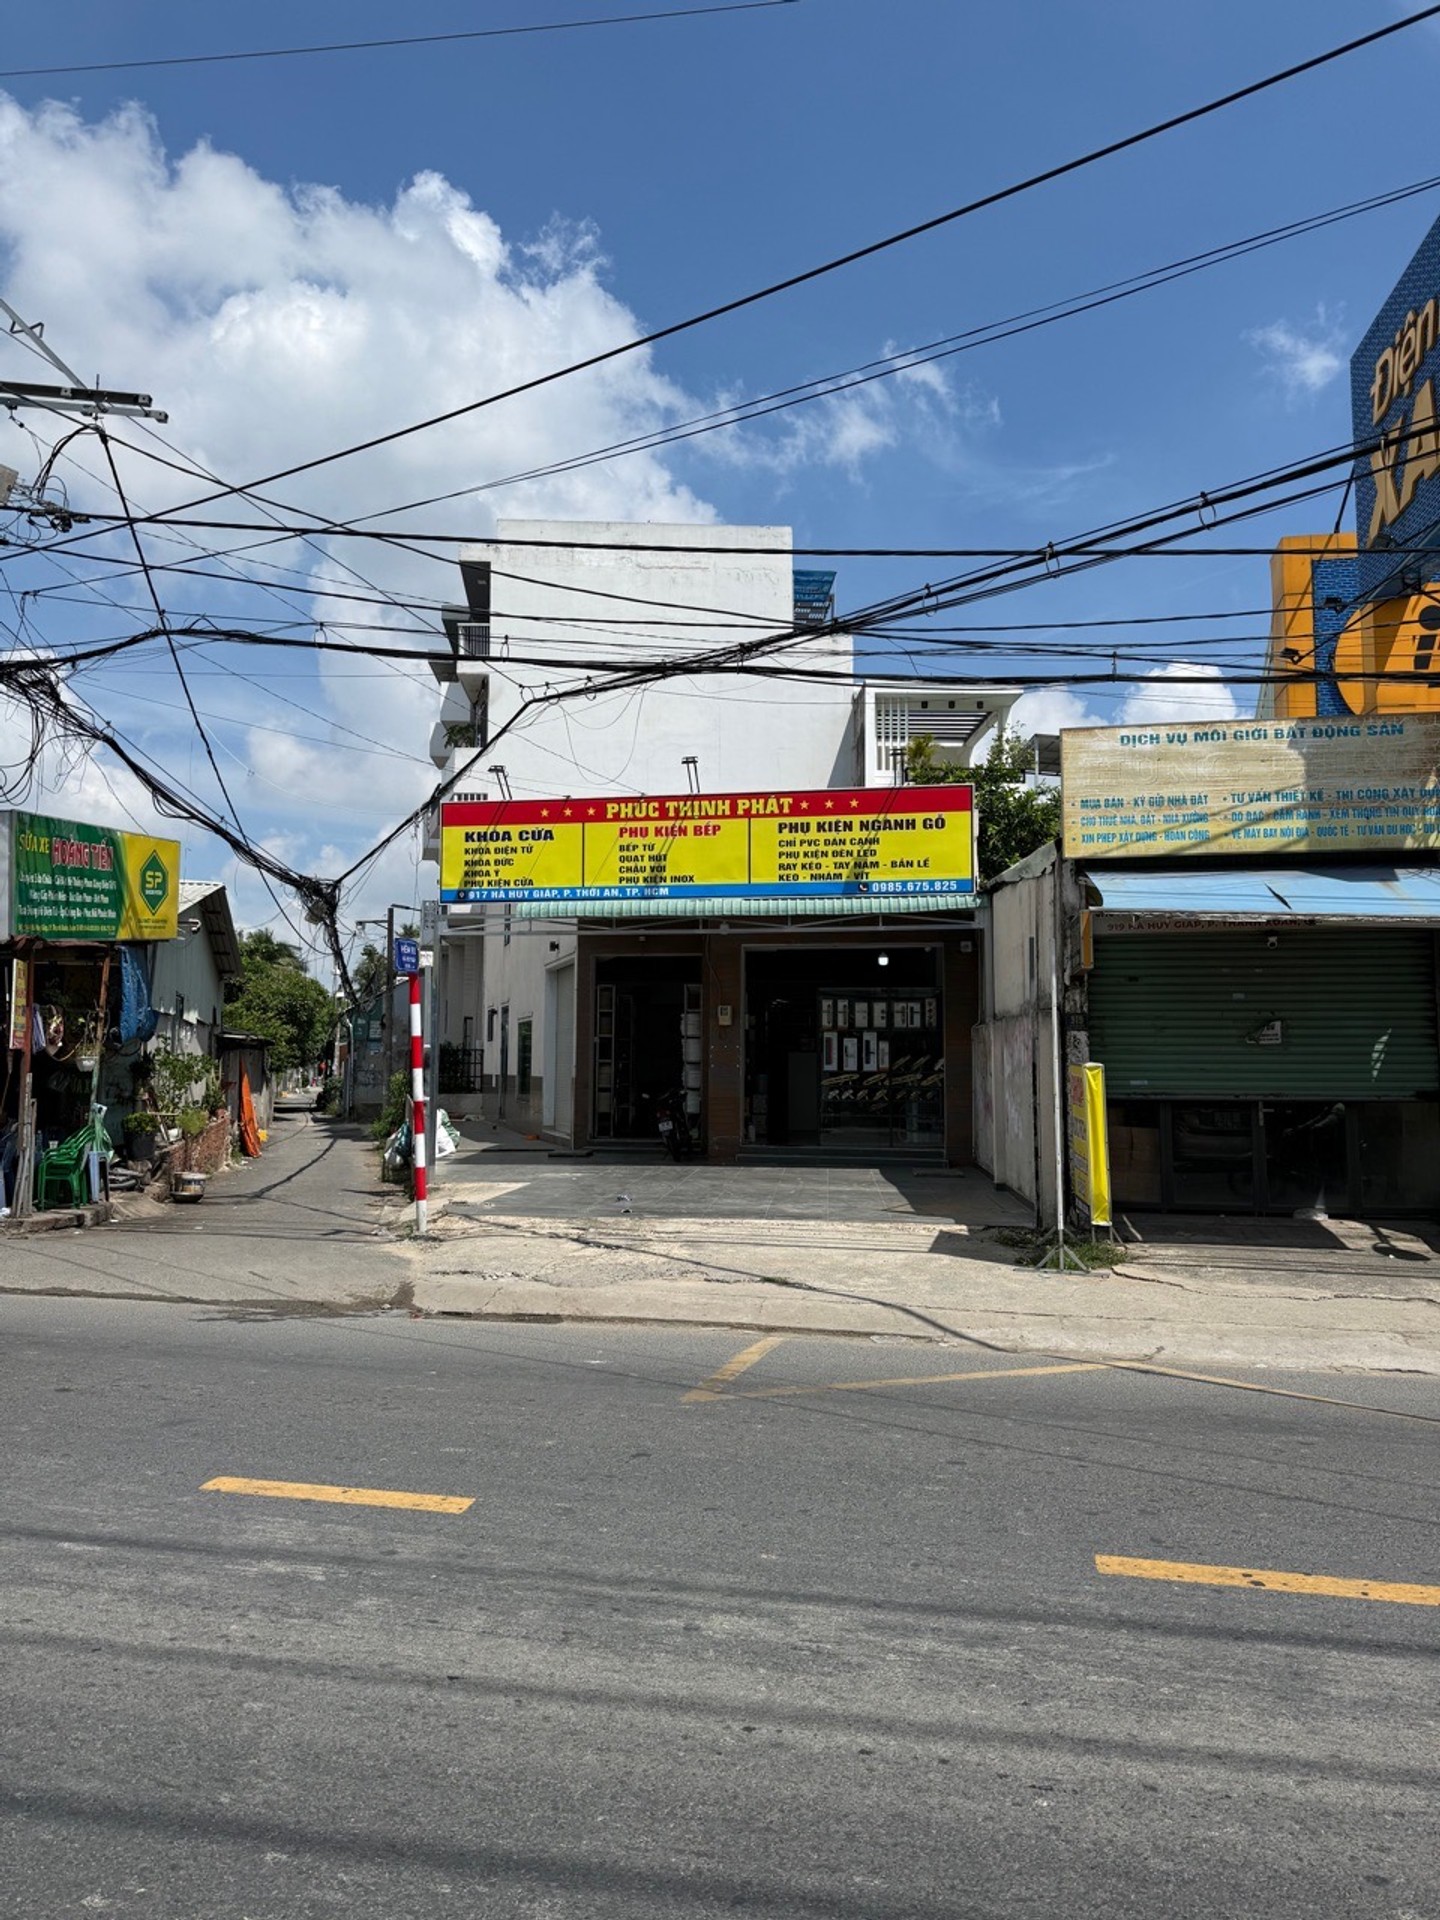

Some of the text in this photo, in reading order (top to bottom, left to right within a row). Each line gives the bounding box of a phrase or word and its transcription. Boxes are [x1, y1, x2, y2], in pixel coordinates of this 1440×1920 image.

[1370, 299, 1435, 425] Điện
[1120, 734, 1160, 747] DỊCH
[1166, 732, 1187, 746] VỤ
[1194, 729, 1226, 742] MÔI
[1233, 728, 1268, 741] GIỚI
[1312, 725, 1361, 740] ĐỘNG
[1367, 721, 1404, 736] SẢN
[1336, 790, 1353, 800] THI
[1357, 788, 1389, 800] CÔNG
[1392, 787, 1415, 799] XÂY
[1080, 799, 1101, 809] MUA
[1104, 797, 1124, 808] BÁN
[1167, 793, 1187, 806] NHÀ
[1190, 791, 1208, 805] ĐẤT
[606, 795, 793, 819] PHÚC THỊNH PHÁT
[619, 821, 721, 839] PHỤ KIỆN BẾP
[778, 814, 946, 835] PHỤ KIỆN NGÀNH GỖ
[464, 827, 554, 842] KHÓA CỬA
[39, 838, 50, 854] XE
[619, 841, 639, 851] BẾP
[778, 837, 796, 848] CHỈ
[800, 838, 820, 847] PVC
[494, 845, 518, 856] ĐIỆN
[521, 844, 533, 854] TỬ
[778, 851, 800, 861] PHỤ
[803, 849, 828, 860] KIỆN
[857, 848, 877, 857] LED
[494, 857, 514, 866] ĐỨC
[778, 862, 797, 871] RAY
[801, 861, 821, 870] KÉO
[833, 861, 851, 870] TAY
[619, 863, 646, 875] CHẬU
[145, 871, 163, 889] SP
[464, 876, 534, 888] PHỤ KIỆN CỬA
[619, 874, 695, 885] PHỤ KIỆN INOX
[778, 873, 799, 882] KEO
[810, 871, 843, 880] NHÁM
[853, 871, 870, 880] VÍT
[872, 880, 957, 892] 0985.675.825
[468, 890, 488, 899] 917
[491, 889, 505, 899] HÀ
[508, 890, 529, 898] HUY
[563, 889, 573, 898] P.
[626, 888, 640, 897] TP.
[644, 887, 669, 896] HCM
